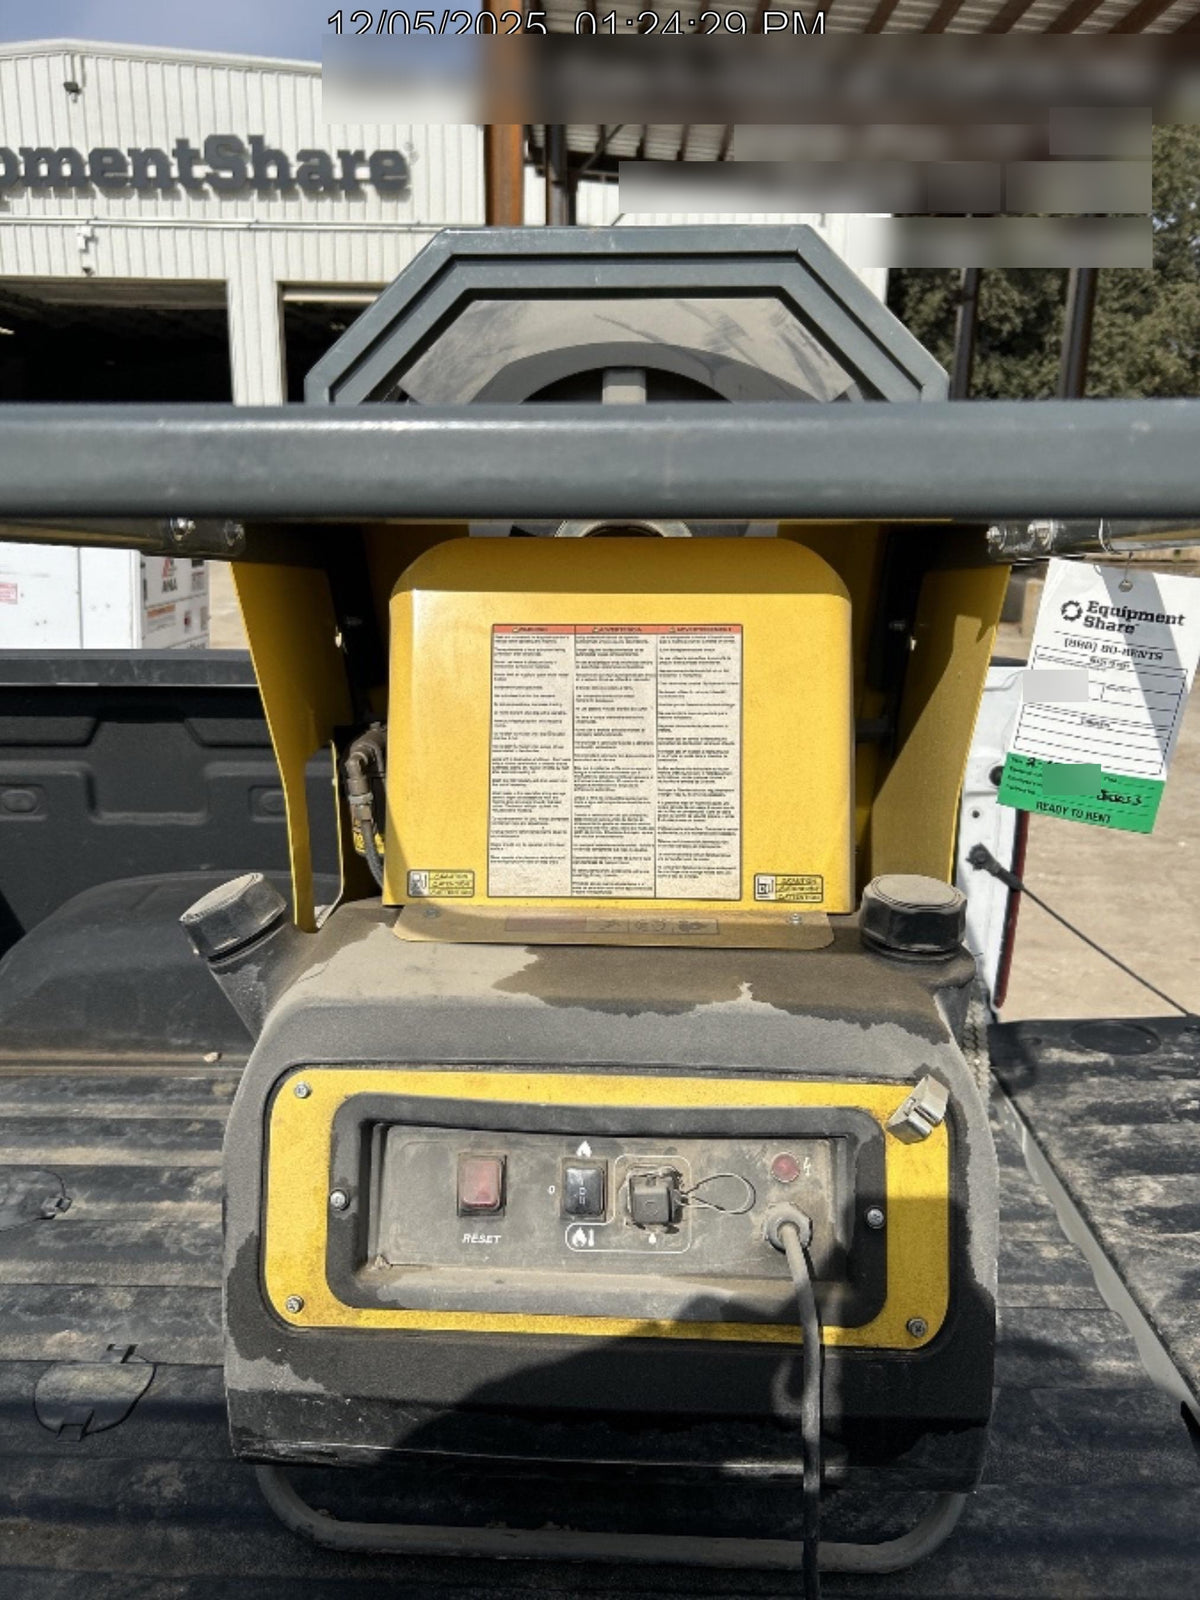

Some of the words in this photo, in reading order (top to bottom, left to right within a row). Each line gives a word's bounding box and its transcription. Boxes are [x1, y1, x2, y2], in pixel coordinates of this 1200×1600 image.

[1086, 600, 1186, 626] Equipment
[1083, 615, 1136, 634] Share
[1036, 801, 1070, 815] READY
[1070, 808, 1085, 818] TO
[1085, 811, 1112, 824] RENT
[461, 1233, 502, 1244] RESET
